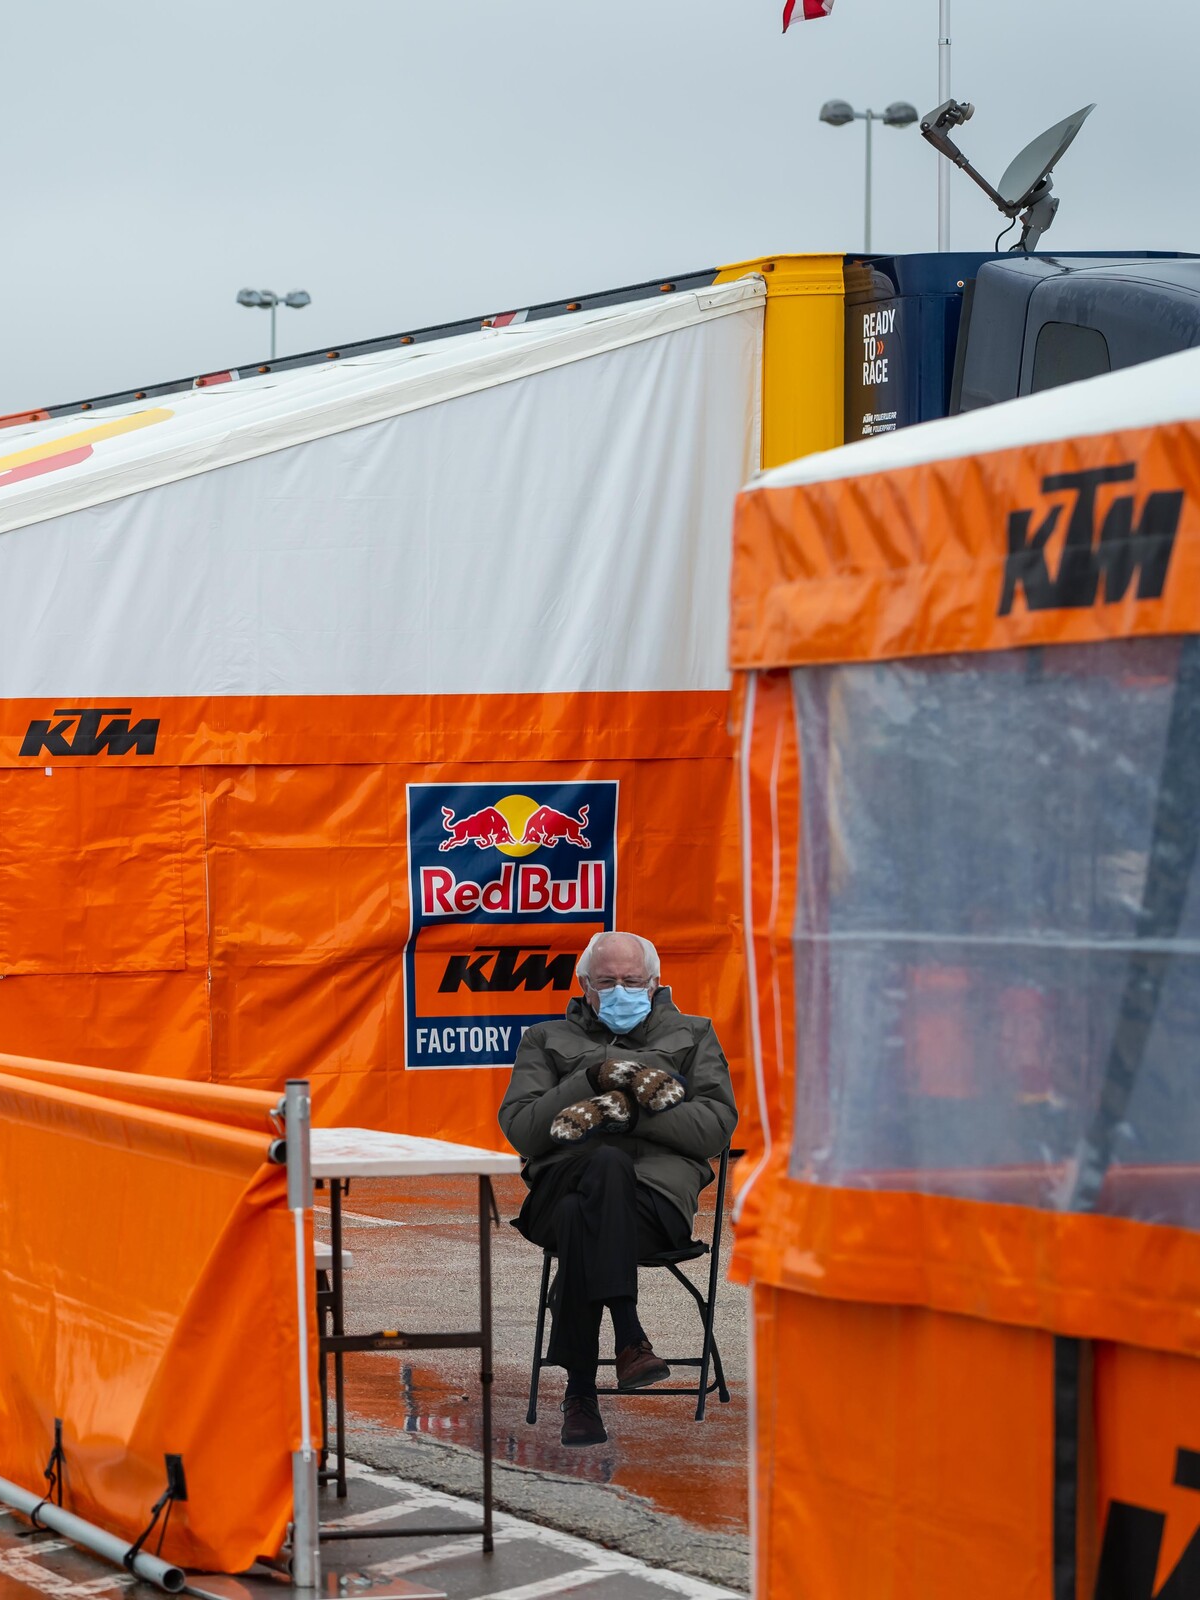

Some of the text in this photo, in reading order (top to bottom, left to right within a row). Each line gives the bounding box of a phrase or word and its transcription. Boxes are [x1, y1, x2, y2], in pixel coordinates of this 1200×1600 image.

[863, 309, 896, 338] READY
[863, 337, 876, 361] TO
[863, 359, 889, 386] RACE
[996, 461, 1185, 617] KTM
[18, 708, 161, 757] KTM
[437, 944, 578, 993] KTM
[416, 1026, 511, 1054] FACTORY
